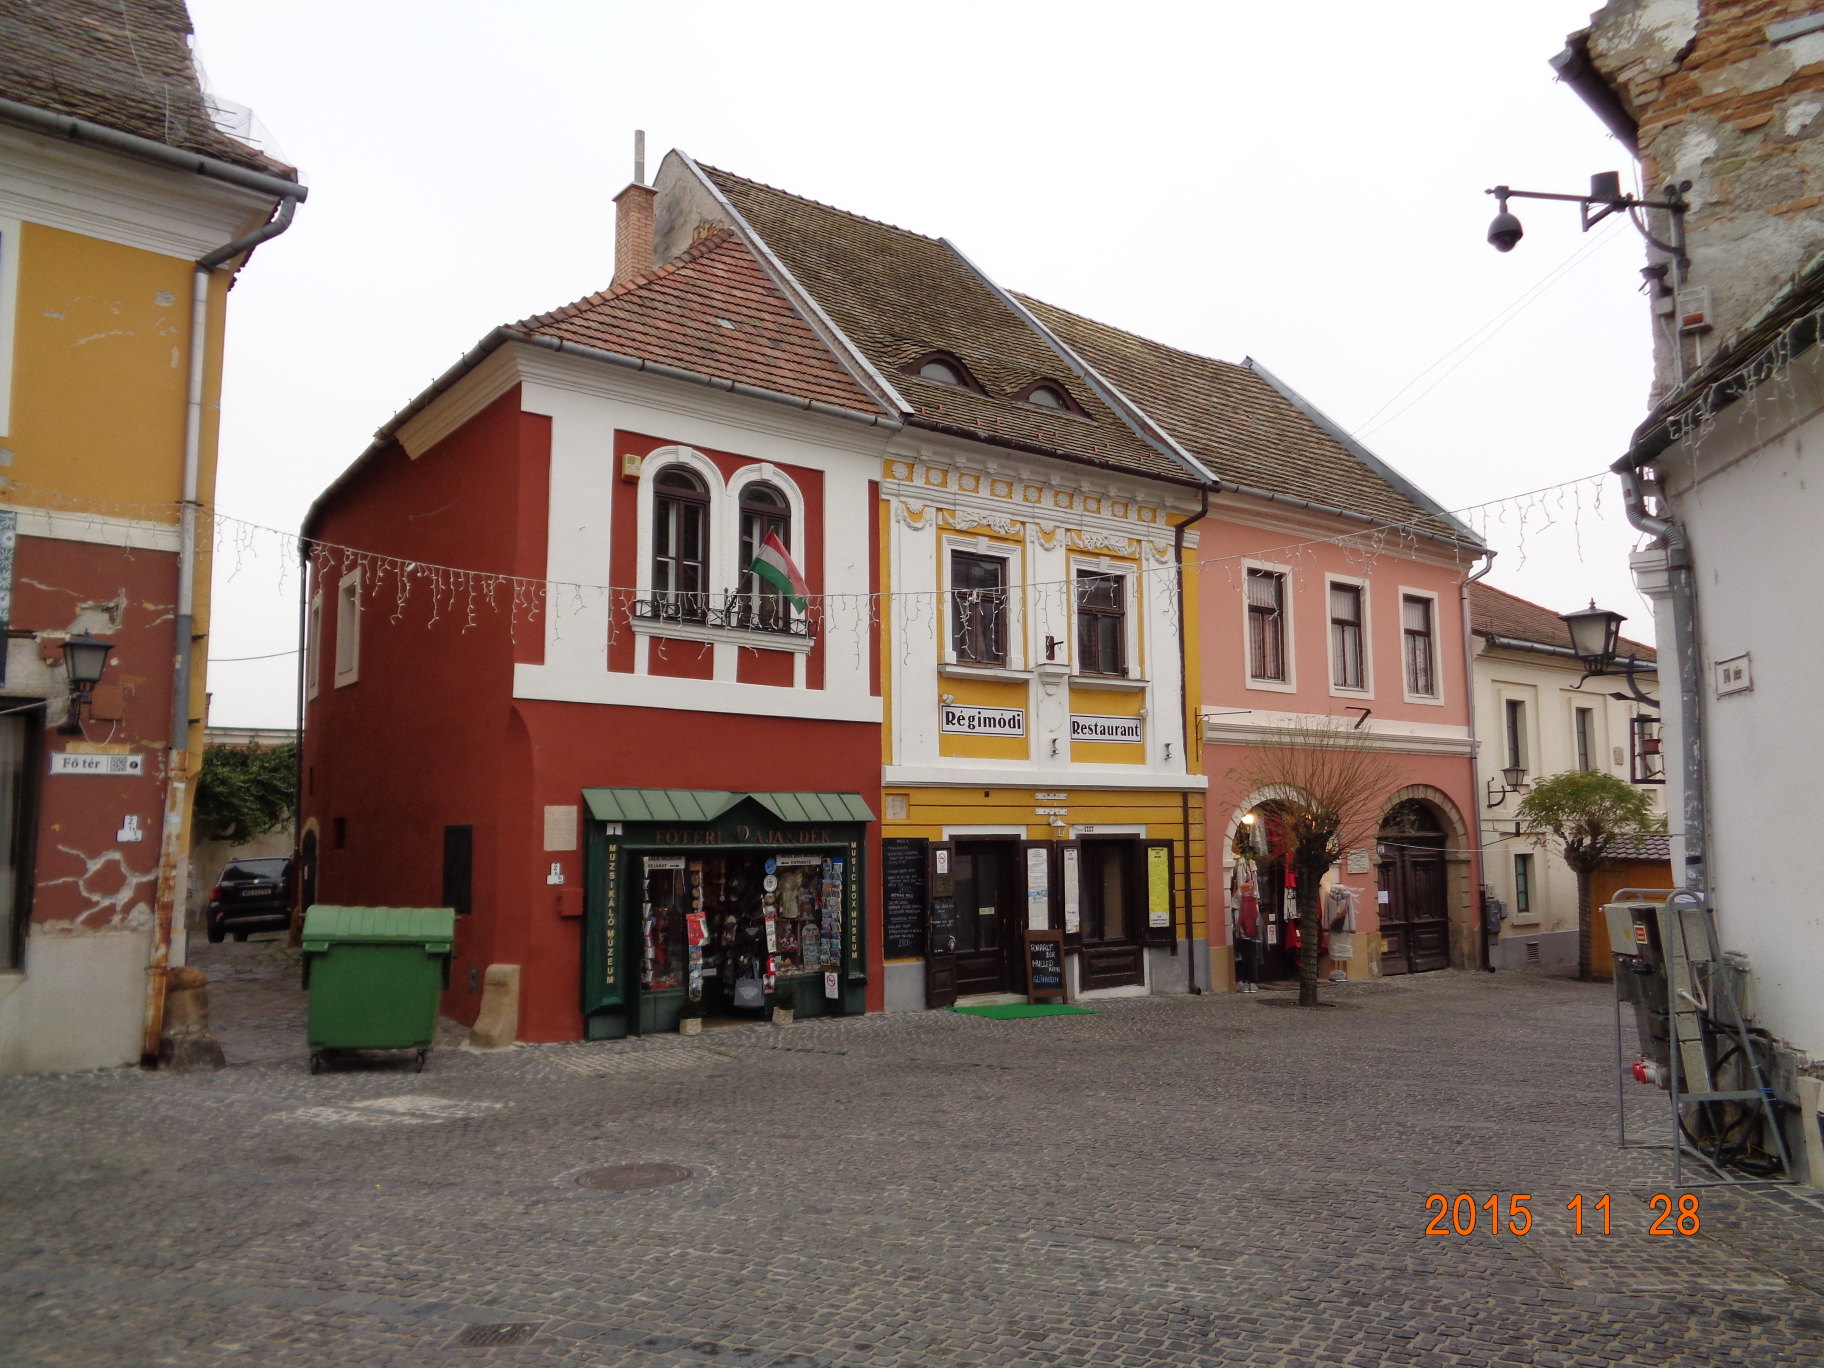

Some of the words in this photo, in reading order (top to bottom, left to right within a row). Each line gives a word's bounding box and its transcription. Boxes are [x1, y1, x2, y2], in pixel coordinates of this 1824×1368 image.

[945, 710, 1021, 730] Régimódi
[1072, 720, 1140, 737] Restaurant
[62, 757, 79, 769] Fő
[82, 758, 100, 769] tér
